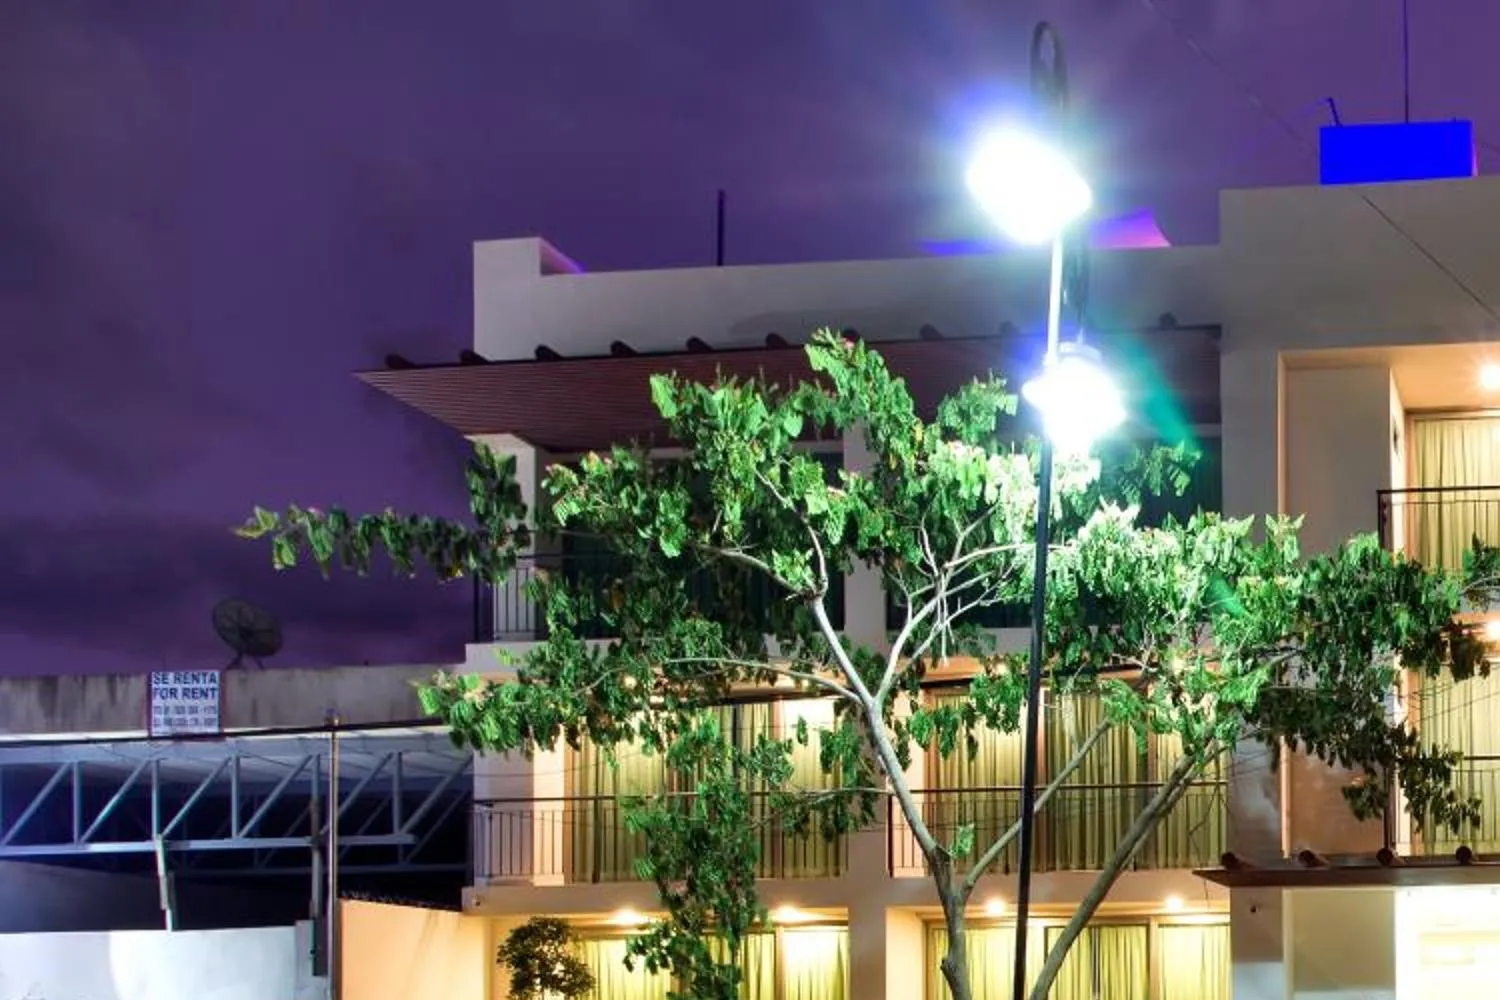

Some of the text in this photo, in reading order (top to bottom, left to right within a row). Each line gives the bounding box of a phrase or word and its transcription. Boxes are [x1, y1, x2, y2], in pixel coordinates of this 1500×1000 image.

[154, 672, 217, 684] SE RENTA
[154, 687, 217, 700] FOR RENT
